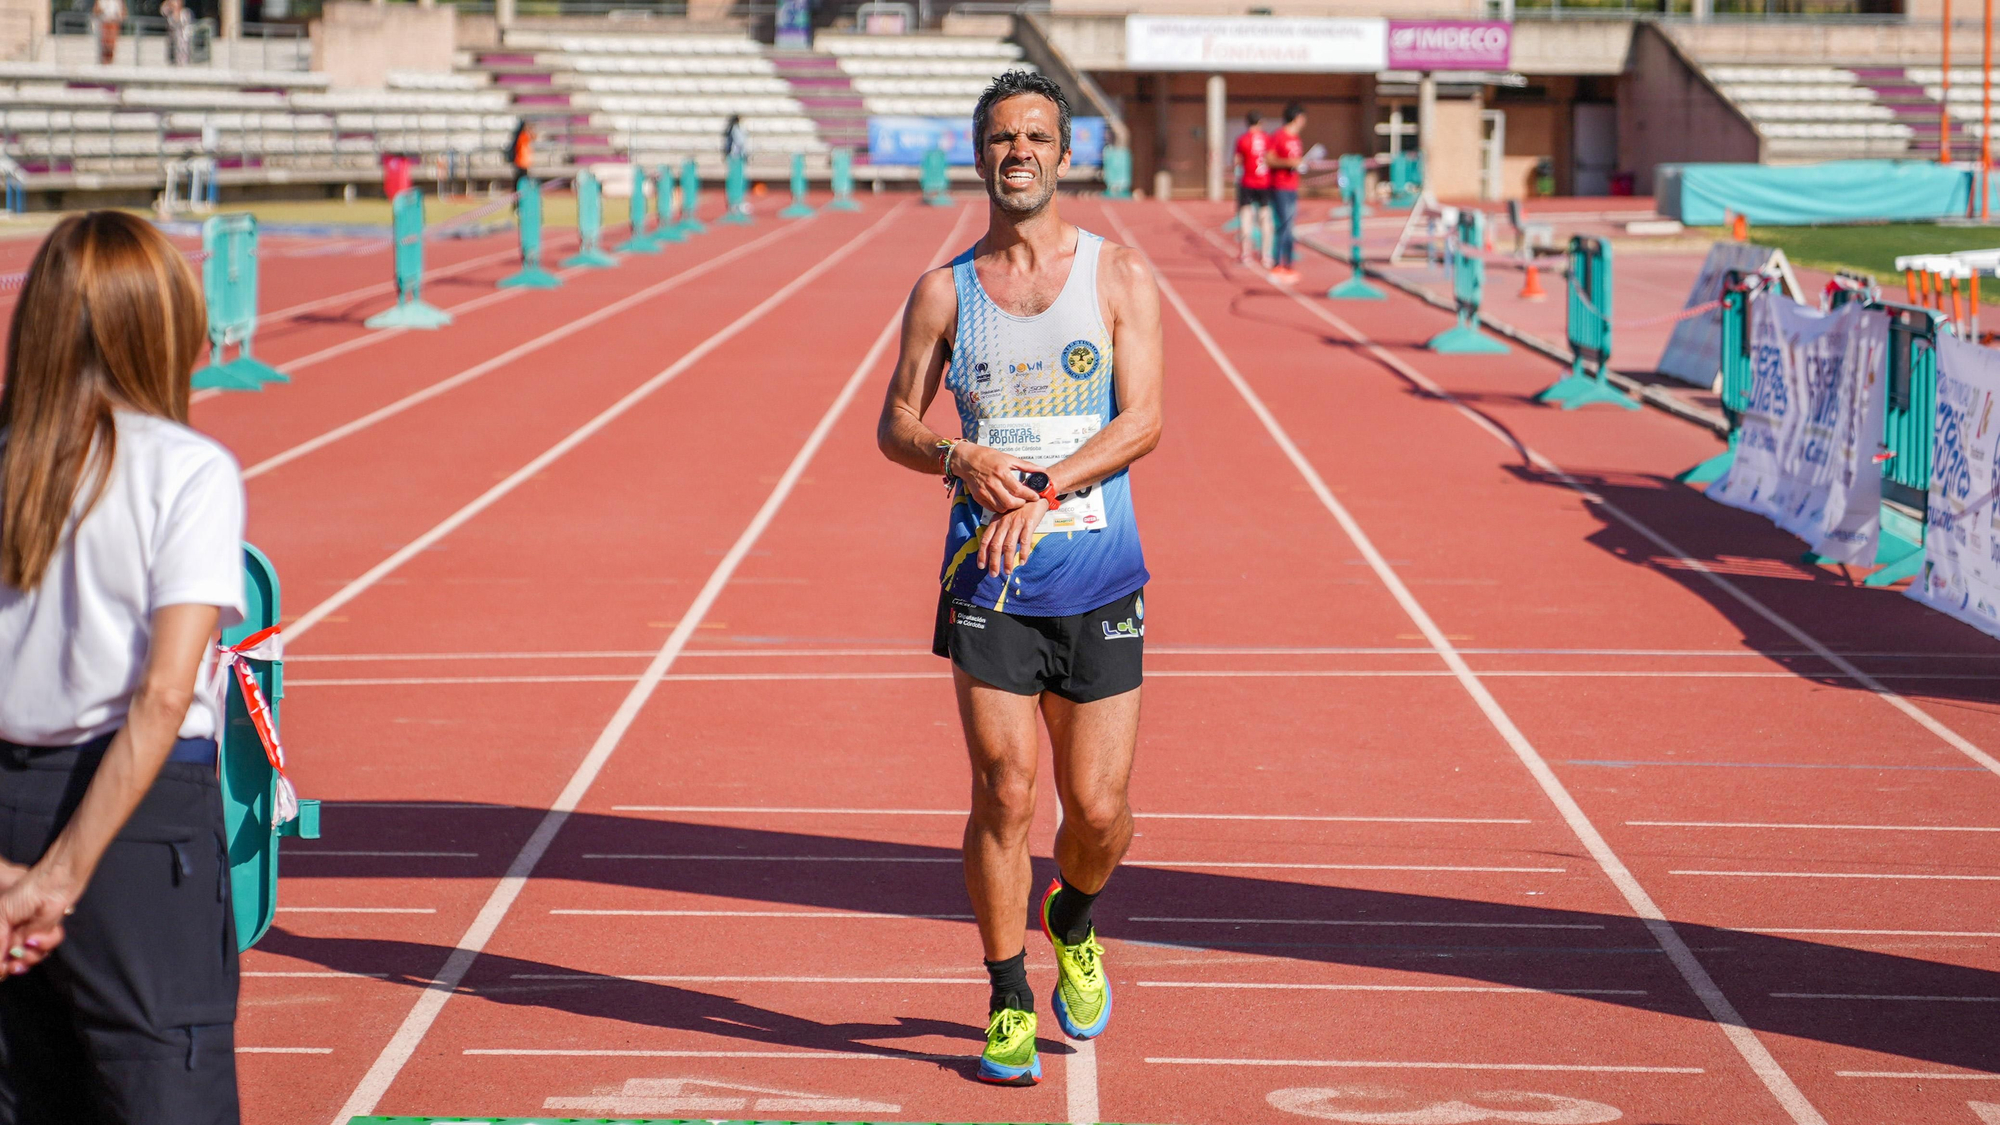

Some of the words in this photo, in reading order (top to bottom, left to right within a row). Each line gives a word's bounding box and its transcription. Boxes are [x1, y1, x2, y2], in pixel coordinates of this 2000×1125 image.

[1415, 26, 1508, 51] IMDECO
[1009, 361, 1043, 373] DOWN
[989, 428, 1033, 437] carreras
[989, 433, 1041, 447] populares
